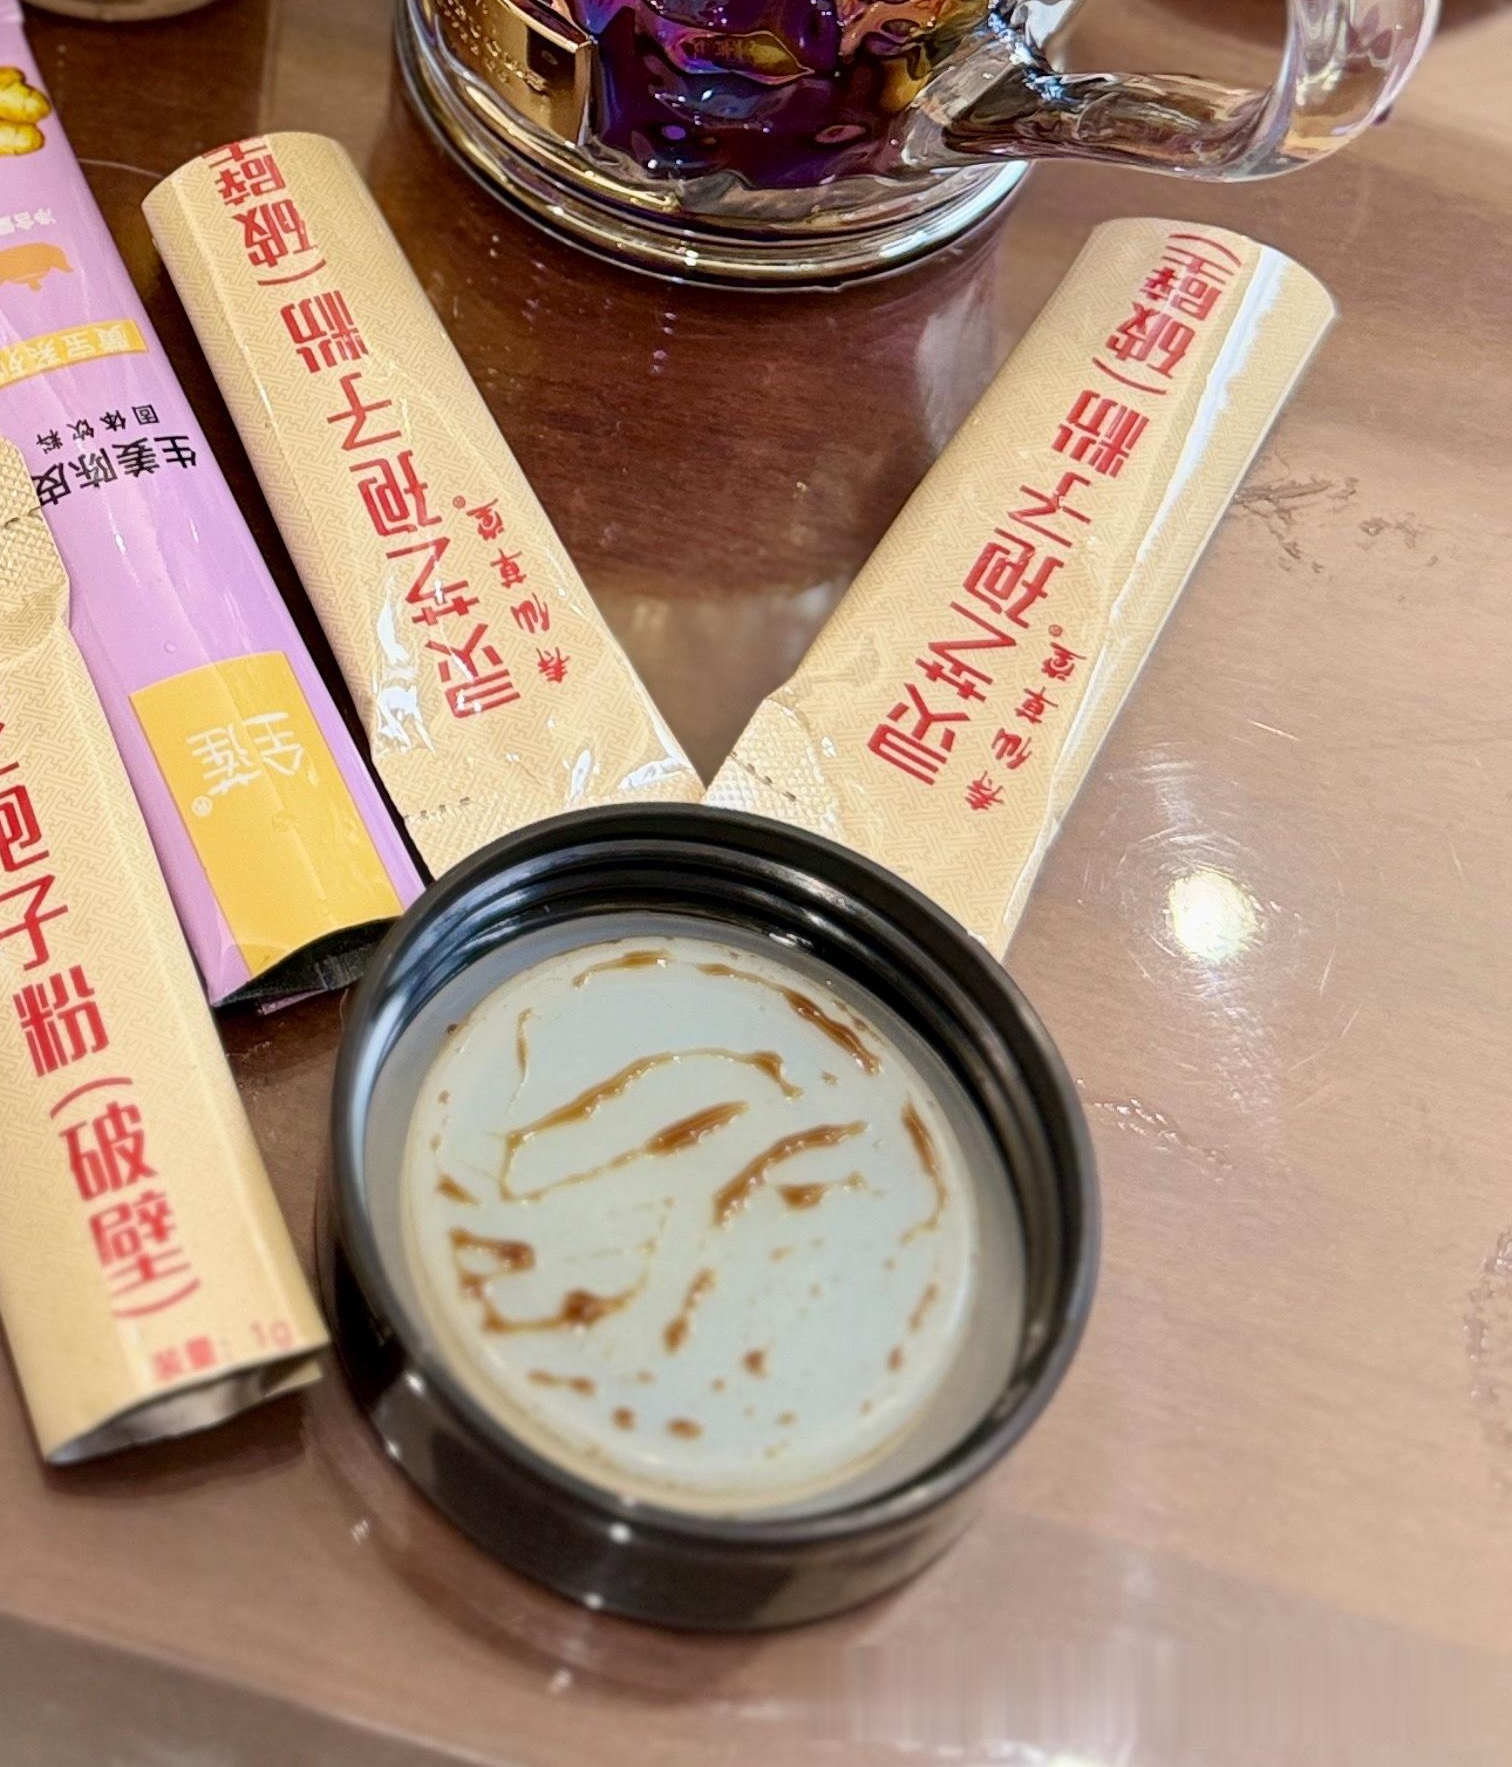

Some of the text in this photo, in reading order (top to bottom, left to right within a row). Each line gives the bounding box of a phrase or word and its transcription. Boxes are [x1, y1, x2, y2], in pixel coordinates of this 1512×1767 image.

[36, 404, 160, 453] 固体饮料
[38, 433, 199, 507] 生姜陈皮
[867, 233, 1243, 785] 灵芝孢子粉（破壁）
